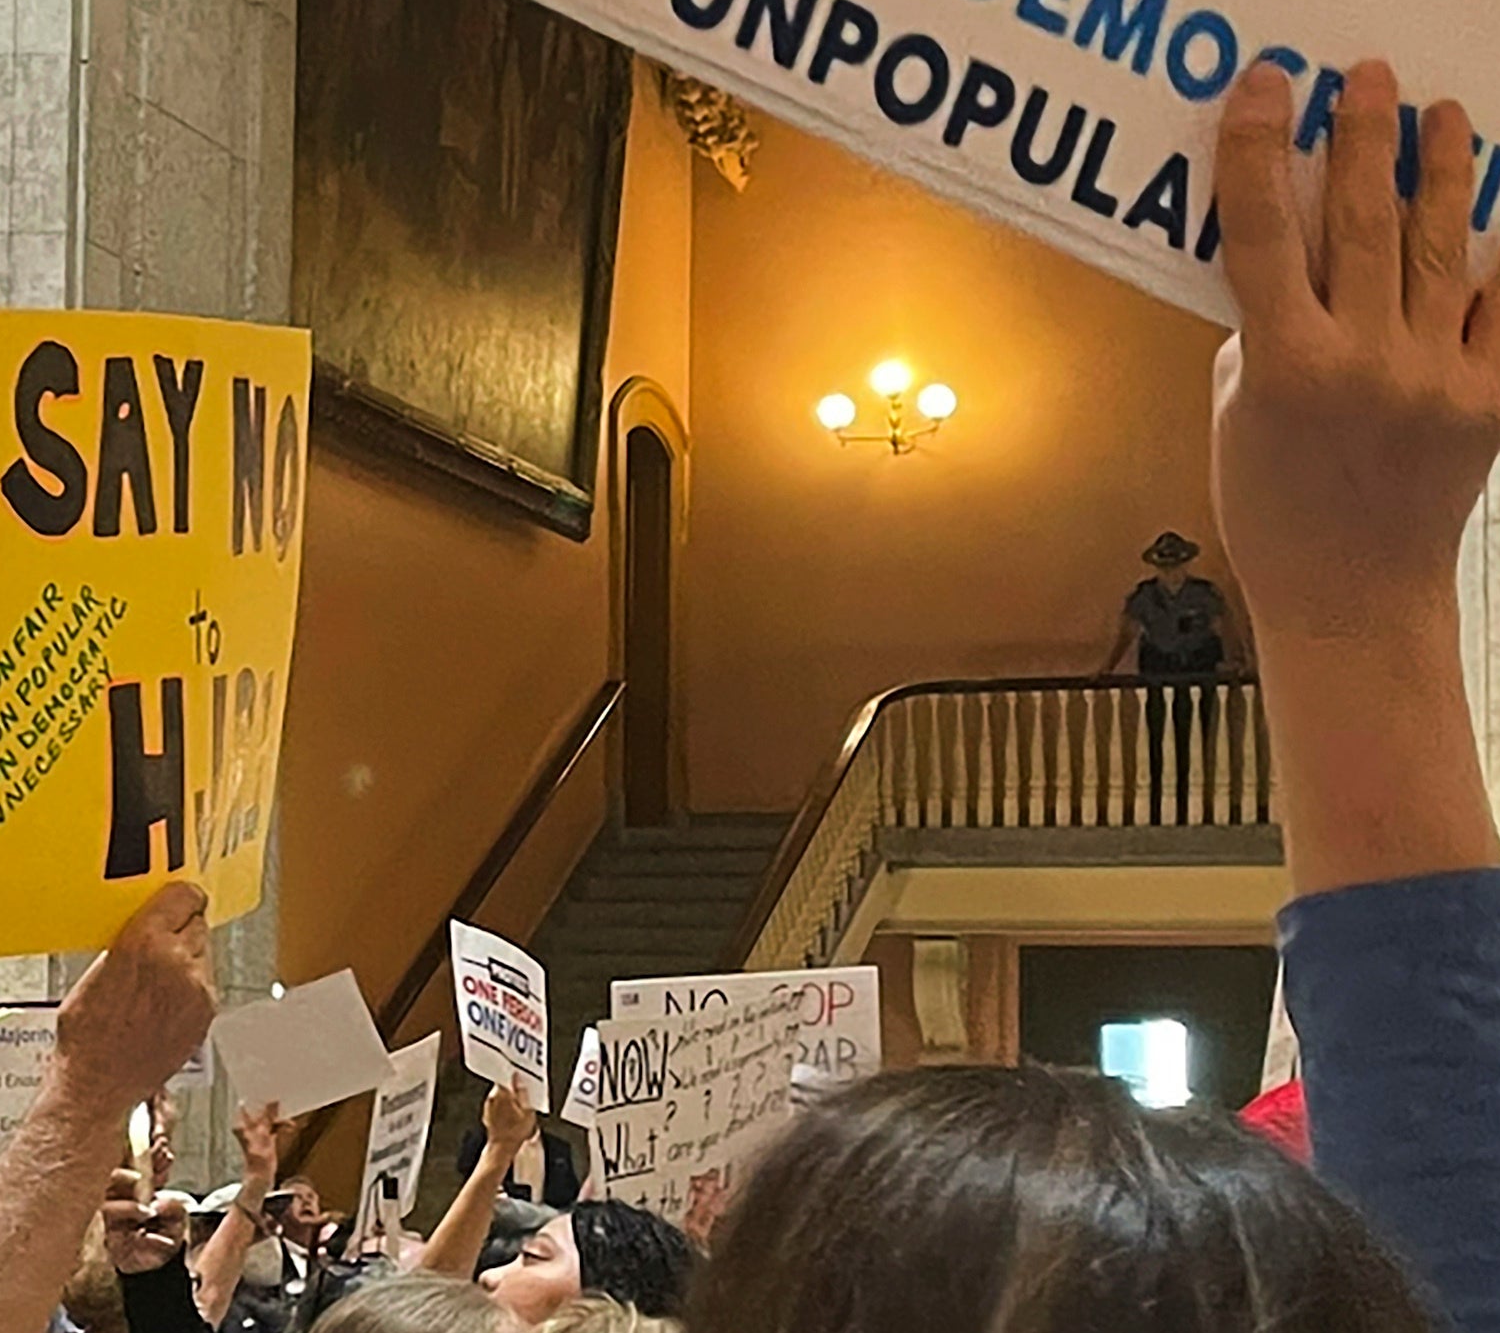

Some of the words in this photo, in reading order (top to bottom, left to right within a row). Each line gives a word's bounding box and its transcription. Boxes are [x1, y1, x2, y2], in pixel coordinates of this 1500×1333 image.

[1, 341, 203, 537] SAY
[232, 377, 300, 561] NO
[188, 589, 221, 665] to
[462, 975, 499, 1004] ONE
[467, 1000, 506, 1040] ONE
[599, 1030, 669, 1105] NOW
